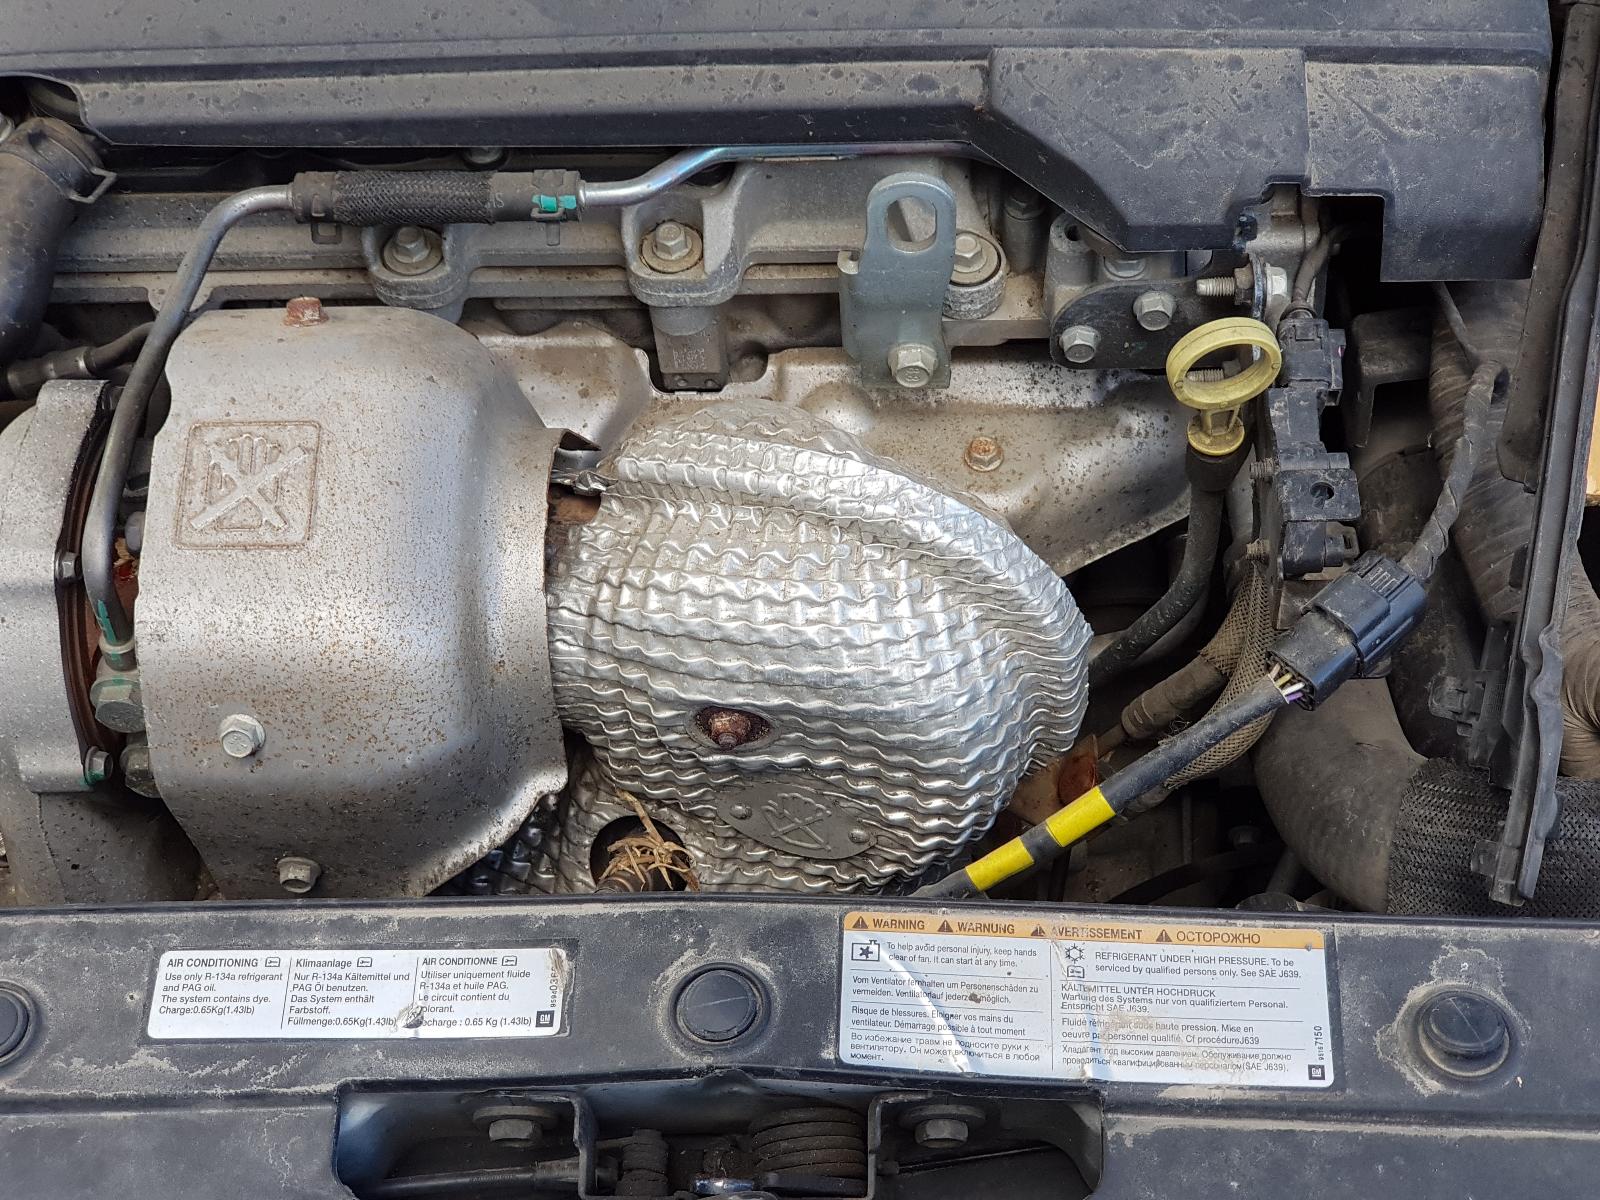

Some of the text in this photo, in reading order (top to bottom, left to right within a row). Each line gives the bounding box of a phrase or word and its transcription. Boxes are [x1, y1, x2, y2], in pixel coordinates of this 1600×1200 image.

[873, 918, 924, 930] WARNING
[958, 922, 1014, 934] WARNUNG
[1176, 931, 1260, 944] ОСТОРОЖНО
[897, 942, 913, 952] help
[915, 943, 935, 952] avoid
[938, 945, 968, 954] personal
[994, 947, 1012, 956] keep
[1014, 948, 1036, 956] hands
[167, 958, 258, 967] AIR CONDITIONING
[296, 958, 352, 969] Klimaanlage
[422, 957, 498, 966] AIR CONDITIONNE
[918, 955, 932, 963] fan.
[957, 957, 972, 965] start
[975, 958, 982, 966] at
[1000, 958, 1018, 967] time.
[1096, 952, 1294, 966] REFRIGERANT UNDER HIGH PRESSURE. To be
[421, 970, 530, 980] Utiliser uniquement fluide
[1096, 964, 1301, 978] serviced by qualified persons only. See SAE J639.
[165, 973, 282, 982] Use only R-134a refrigerant
[294, 973, 410, 981] Nur R-134a Kältemittel und
[314, 982, 324, 992] Öl
[420, 982, 450, 990] R-134a
[487, 982, 508, 990] PAG.
[872, 976, 905, 986] Ventilator
[908, 979, 944, 988] fernhalten
[960, 982, 1027, 992] Personenschäden
[418, 994, 428, 1002] Le
[432, 993, 458, 1001] circuit
[460, 993, 496, 1001] contient
[852, 989, 894, 997] vermeiden.
[946, 992, 979, 1002] jederz
[1124, 987, 1154, 995] UNTER
[1156, 988, 1216, 998] HOCHDRUCK
[162, 995, 270, 1004] The system contains dye.
[290, 995, 374, 1004] Das System enthält
[1062, 993, 1096, 1002] Wartung
[1117, 996, 1152, 1004] Systems
[1190, 998, 1246, 1008] qualifiziertem
[1249, 1000, 1288, 1008] Personal.
[160, 1006, 254, 1015] Charge:0.65Kg(1.43lb)
[290, 1006, 330, 1014] Farbstoff.
[420, 1005, 454, 1013] olorant.
[852, 1006, 878, 1015] Risque
[880, 1007, 889, 1015] de
[892, 1008, 929, 1018] blessures.
[1062, 1002, 1150, 1014] Entspricht SAE J639.
[288, 1017, 397, 1027] Füllmenge:0.65Kg(1.43lb)
[420, 1018, 457, 1028] echarge
[464, 1018, 483, 1026] 0.65
[486, 1018, 498, 1028] Kg
[500, 1017, 532, 1027] (1.43lb)
[852, 1019, 892, 1028] ventilateur.
[894, 1020, 935, 1031] Démarrage
[938, 1024, 968, 1032] possible
[978, 1026, 992, 1034] tout
[995, 1028, 1026, 1036] moment
[1156, 1022, 1179, 1030] haute
[1182, 1024, 1218, 1032] pression.
[1222, 1024, 1240, 1032] Mise
[1186, 1034, 1195, 1042] Cf
[1198, 1036, 1260, 1045] procédureJ639
[1002, 1044, 1022, 1052] руки
